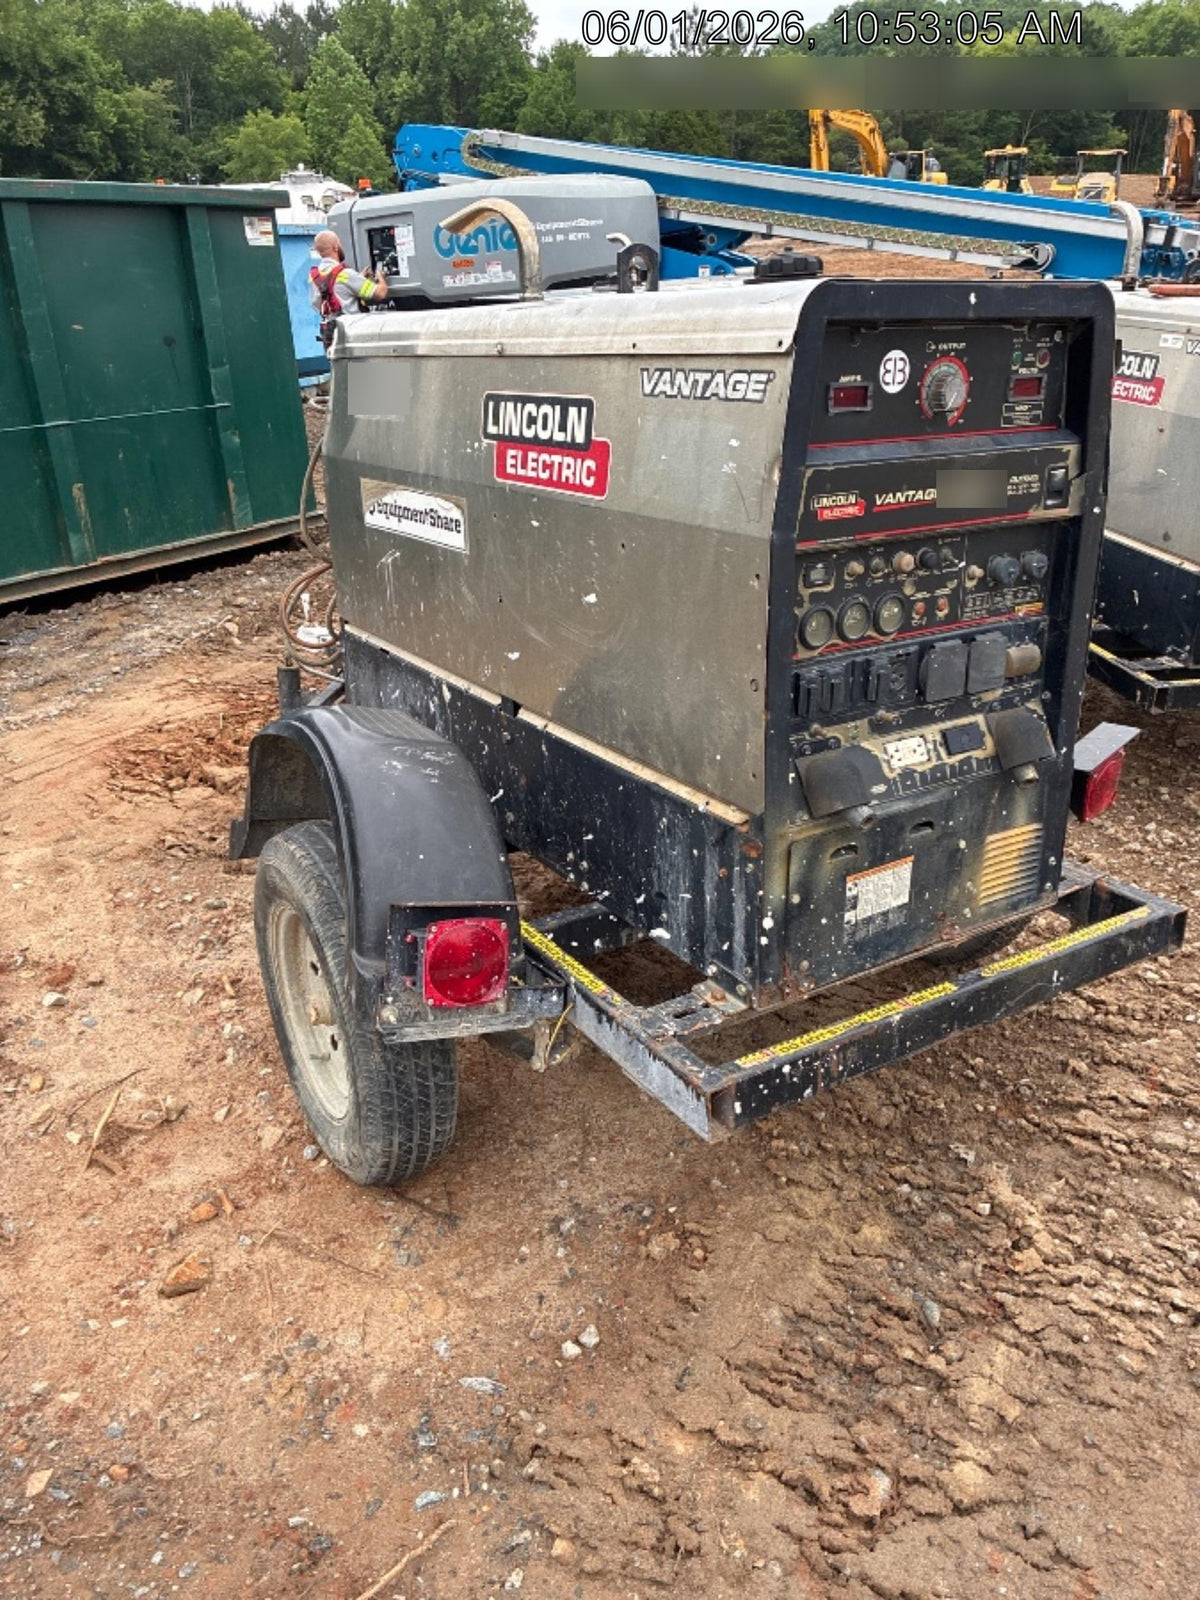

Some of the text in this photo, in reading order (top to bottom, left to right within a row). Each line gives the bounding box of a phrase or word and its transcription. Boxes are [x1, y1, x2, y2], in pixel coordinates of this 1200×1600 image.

[640, 367, 770, 403] VANTAGE
[486, 401, 588, 444] LINCOLN
[506, 448, 596, 488] ELECTRIC
[813, 493, 856, 508] LINCOLN
[875, 488, 937, 506] VANTAG
